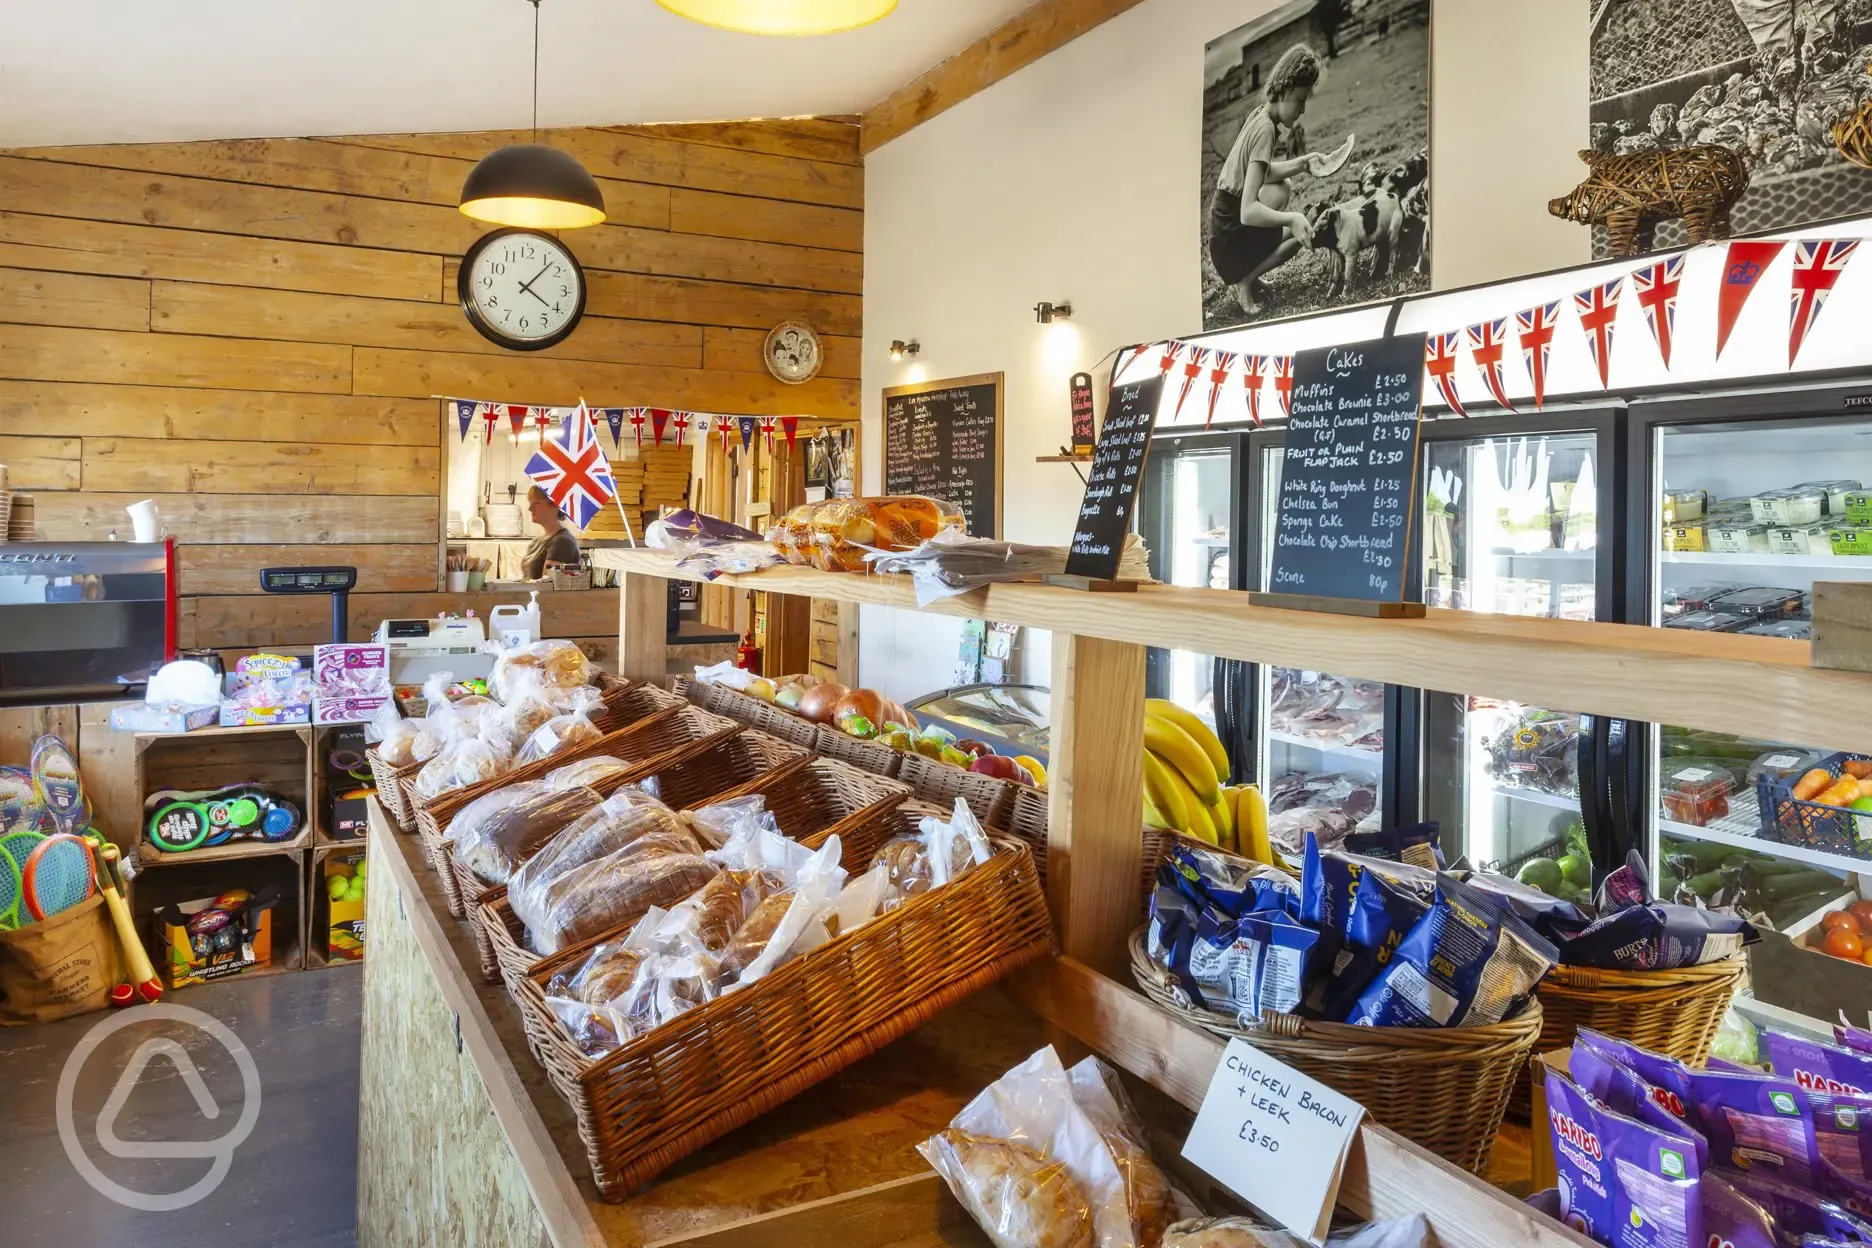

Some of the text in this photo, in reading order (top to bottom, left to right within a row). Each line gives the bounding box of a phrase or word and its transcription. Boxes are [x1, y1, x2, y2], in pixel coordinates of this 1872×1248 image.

[505, 250, 516, 263] 11
[521, 247, 535, 260] 12
[543, 253, 547, 265] 1
[491, 262, 505, 275] 10
[552, 266, 561, 278] 2
[483, 276, 493, 289] 9
[560, 285, 568, 297] 3
[488, 295, 498, 308] 8
[551, 301, 561, 314] 4
[504, 309, 512, 322] 7
[519, 315, 529, 329] 6
[540, 313, 548, 326] 5
[1326, 348, 1364, 373] Cakes
[1121, 384, 1140, 403] Bread
[1294, 383, 1335, 399] Muffins
[1292, 399, 1333, 415] Chocolate
[1338, 393, 1373, 410] Brownie
[1290, 403, 1419, 431] Chocolate Caramel Shortbread
[1287, 441, 1364, 460] FRUIT OR PLAIN
[1284, 479, 1308, 492] White
[1310, 481, 1327, 499] Ring
[1330, 478, 1367, 500] Doughnut
[1283, 496, 1317, 510] Chelsea
[1322, 497, 1339, 509] Bun
[1282, 514, 1314, 534] Sponge
[1319, 513, 1345, 528] Cake
[1279, 532, 1394, 551] Chocolate Chip Shortbread
[1276, 567, 1388, 595] Scone 80p
[244, 656, 286, 670] Squeezy
[1613, 937, 1648, 960] BURTS
[1226, 1055, 1348, 1128] CHICKEN BACON
[1237, 1086, 1292, 1125] + LEEK
[1550, 1106, 1602, 1161] HARIBO
